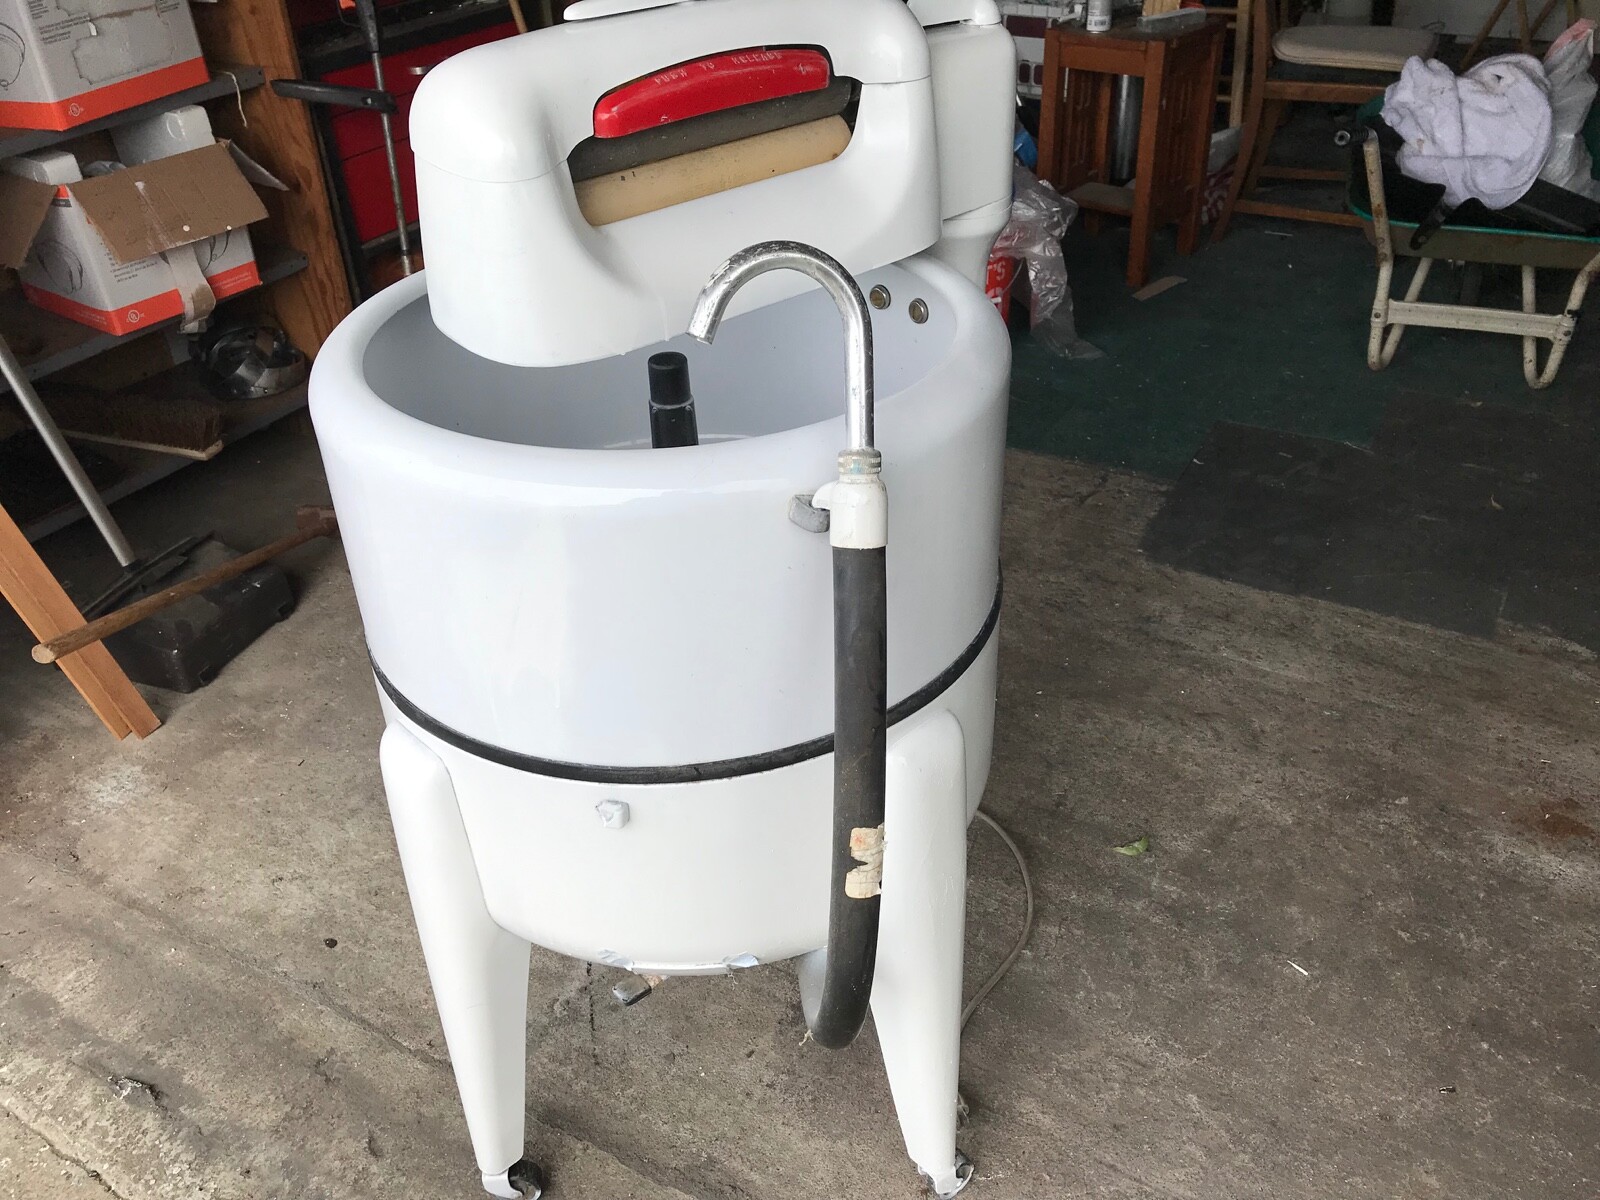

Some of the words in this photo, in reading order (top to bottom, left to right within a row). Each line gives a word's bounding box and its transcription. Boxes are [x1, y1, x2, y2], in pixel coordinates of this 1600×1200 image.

[654, 69, 688, 85] PUSH
[698, 61, 715, 71] TO
[731, 52, 783, 64] RELEASE
